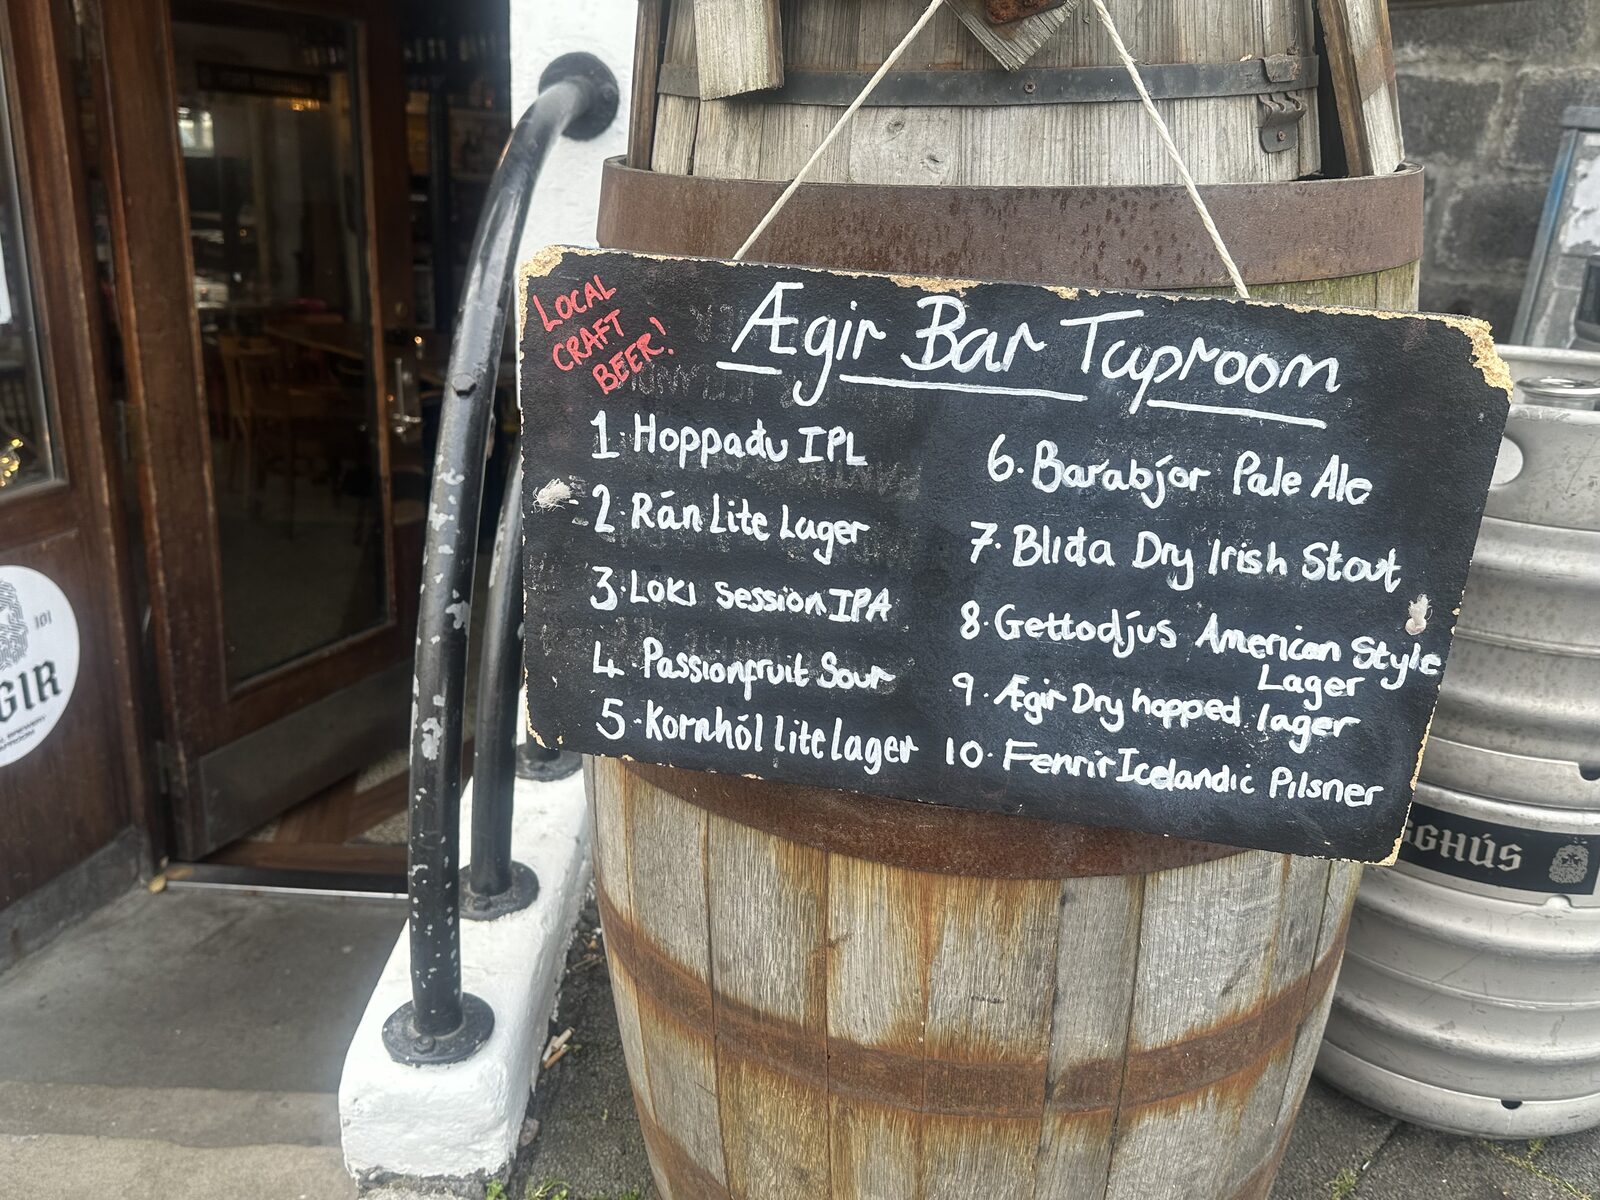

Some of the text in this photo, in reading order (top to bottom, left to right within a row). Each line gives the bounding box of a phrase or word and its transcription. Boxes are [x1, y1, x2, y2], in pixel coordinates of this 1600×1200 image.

[533, 275, 616, 331] LOCAL
[553, 309, 624, 371] CRAFT
[593, 317, 673, 394] BEER!
[731, 282, 887, 406] Ægir
[901, 295, 1046, 373] Bar
[1060, 309, 1340, 414] Taproom
[798, 426, 868, 466] IPL
[1233, 450, 1301, 497] Pale
[1310, 455, 1373, 505] Ale
[632, 490, 702, 533] Rán
[710, 493, 770, 541] Lite
[780, 504, 870, 565] Lager
[1132, 531, 1194, 591] Dry
[1208, 538, 1287, 576] Irish
[1302, 540, 1401, 593] Stout
[828, 587, 892, 623] IPA
[643, 636, 808, 701] Passionfruit
[817, 651, 895, 690] Sour
[1195, 613, 1341, 662] American
[1351, 636, 1442, 691] Style
[994, 674, 1067, 725] Ægir
[1072, 683, 1124, 732] Dry
[1132, 688, 1240, 729] hopped
[1257, 704, 1361, 754] lager
[1258, 664, 1365, 711] Lager
[645, 700, 763, 752] Kornhól
[775, 714, 825, 760] lite
[831, 718, 919, 774] lager
[1002, 738, 1115, 778] Fenrir
[1116, 747, 1255, 794] Icelandic
[1269, 766, 1384, 807] Pilsner
